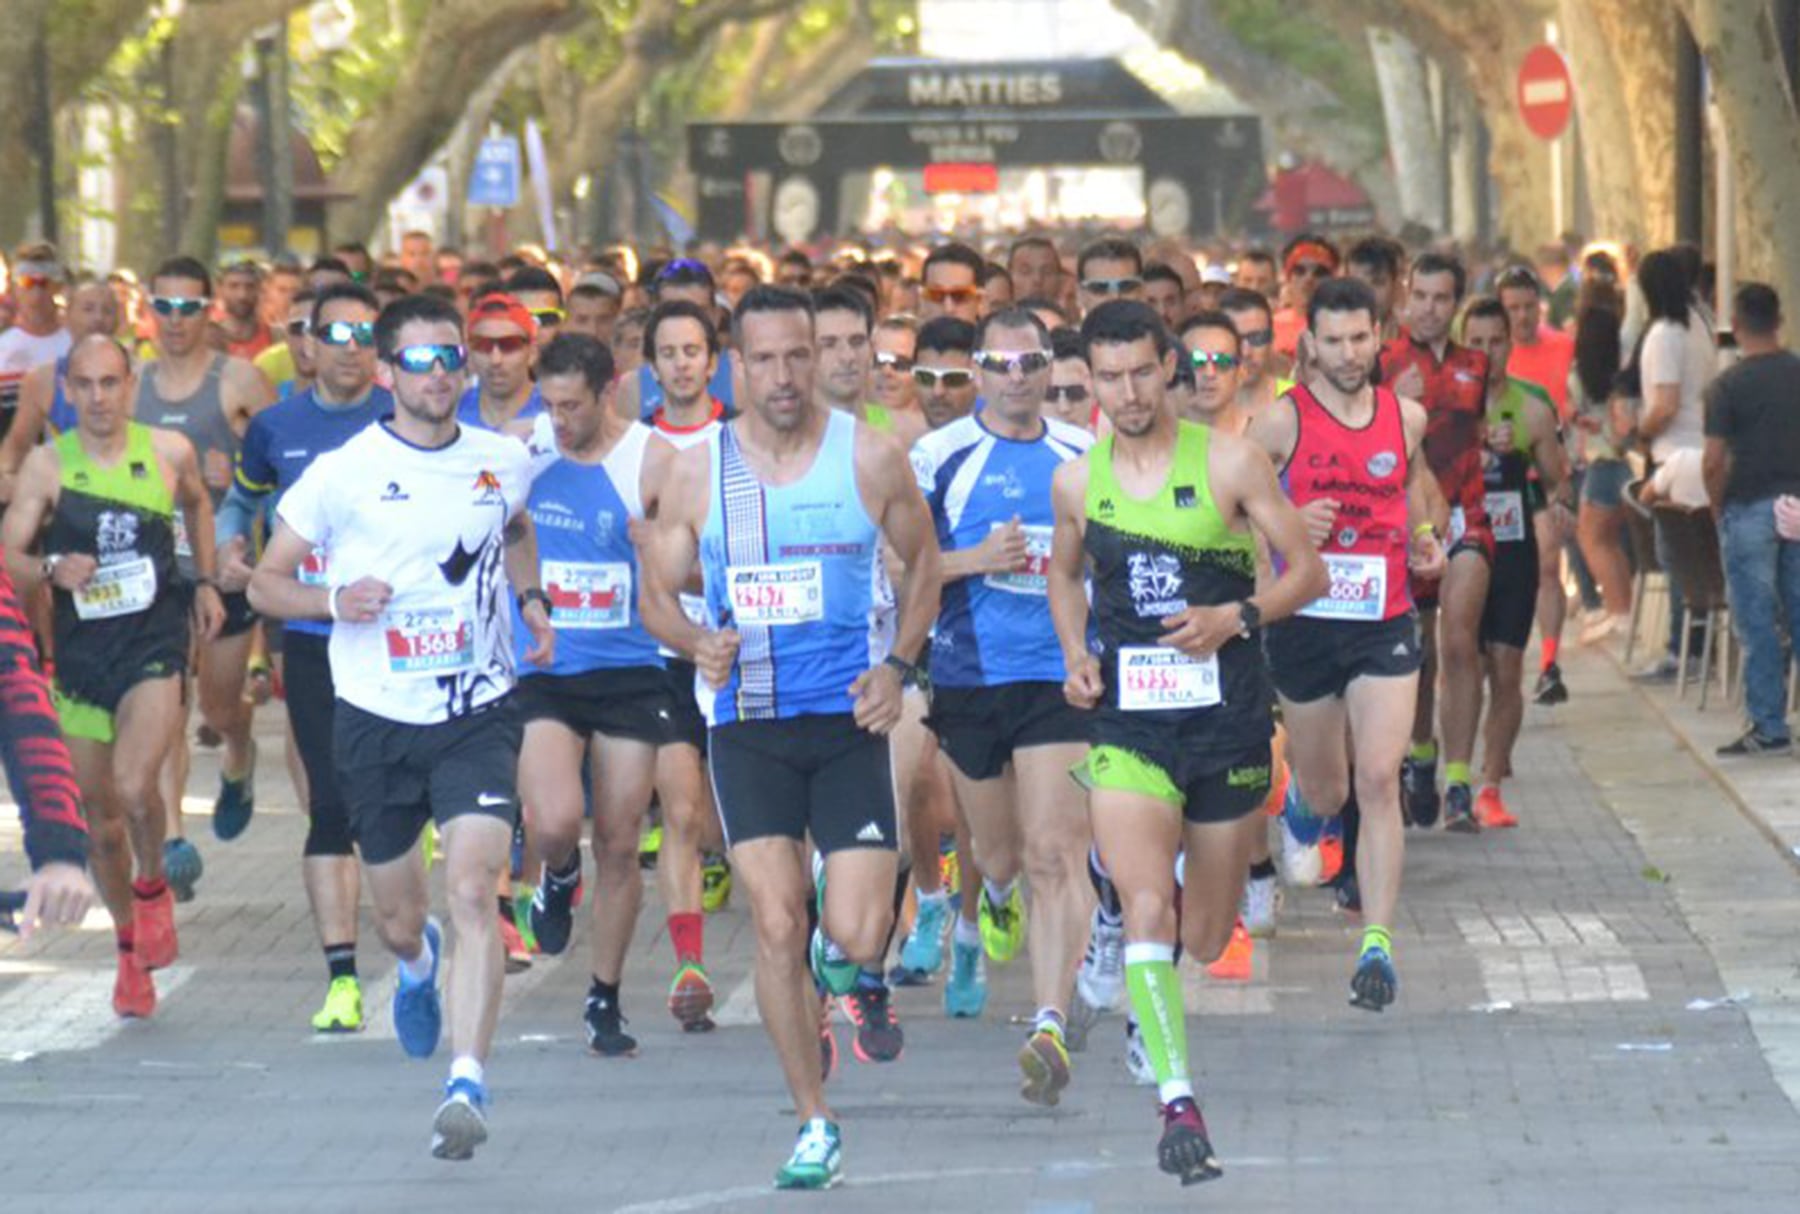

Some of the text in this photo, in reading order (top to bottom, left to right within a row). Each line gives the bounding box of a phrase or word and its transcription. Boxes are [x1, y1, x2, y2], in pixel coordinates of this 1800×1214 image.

[909, 73, 1062, 105] MATTIES
[579, 591, 592, 608] 2
[1328, 582, 1364, 601] 600
[408, 630, 458, 657] 1568
